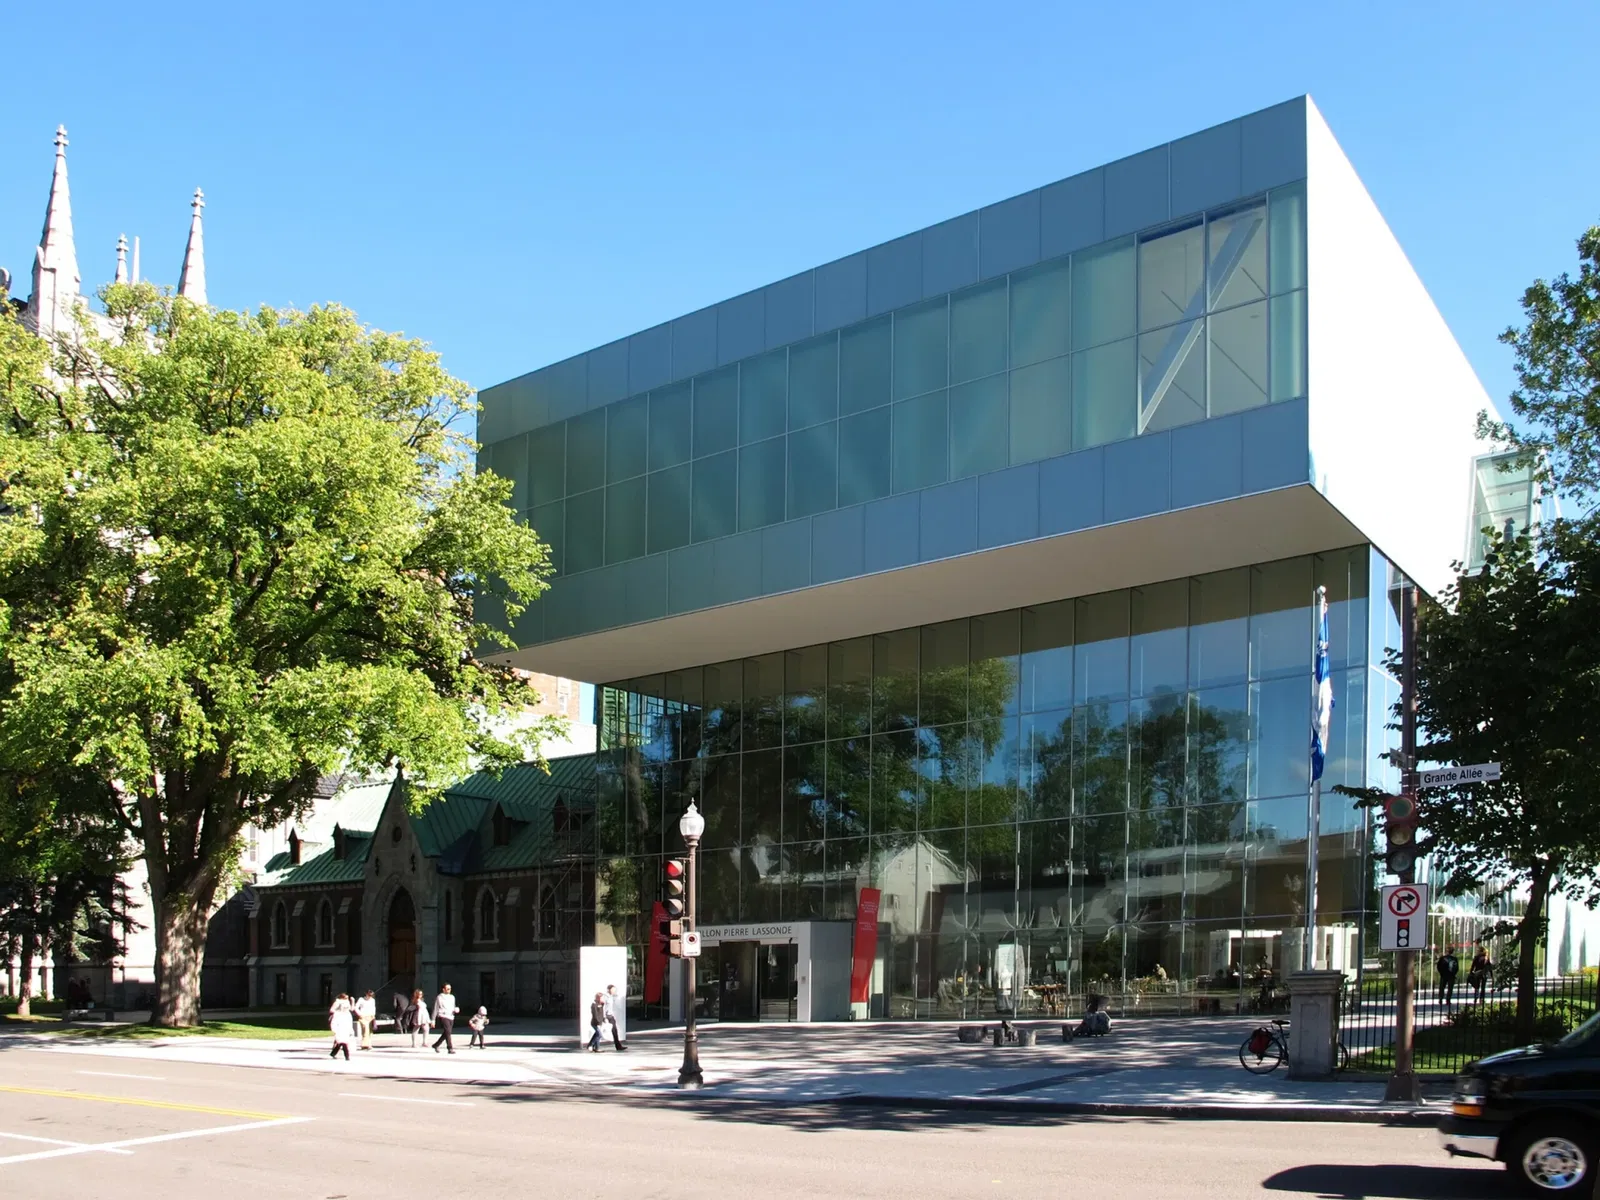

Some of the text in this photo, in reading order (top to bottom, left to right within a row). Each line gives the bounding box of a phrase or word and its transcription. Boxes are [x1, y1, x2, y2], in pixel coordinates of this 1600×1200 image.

[1424, 771, 1457, 784] Grande
[1460, 768, 1483, 779] Allée
[724, 929, 748, 937] PIERRE
[752, 926, 792, 935] LASSONDE
